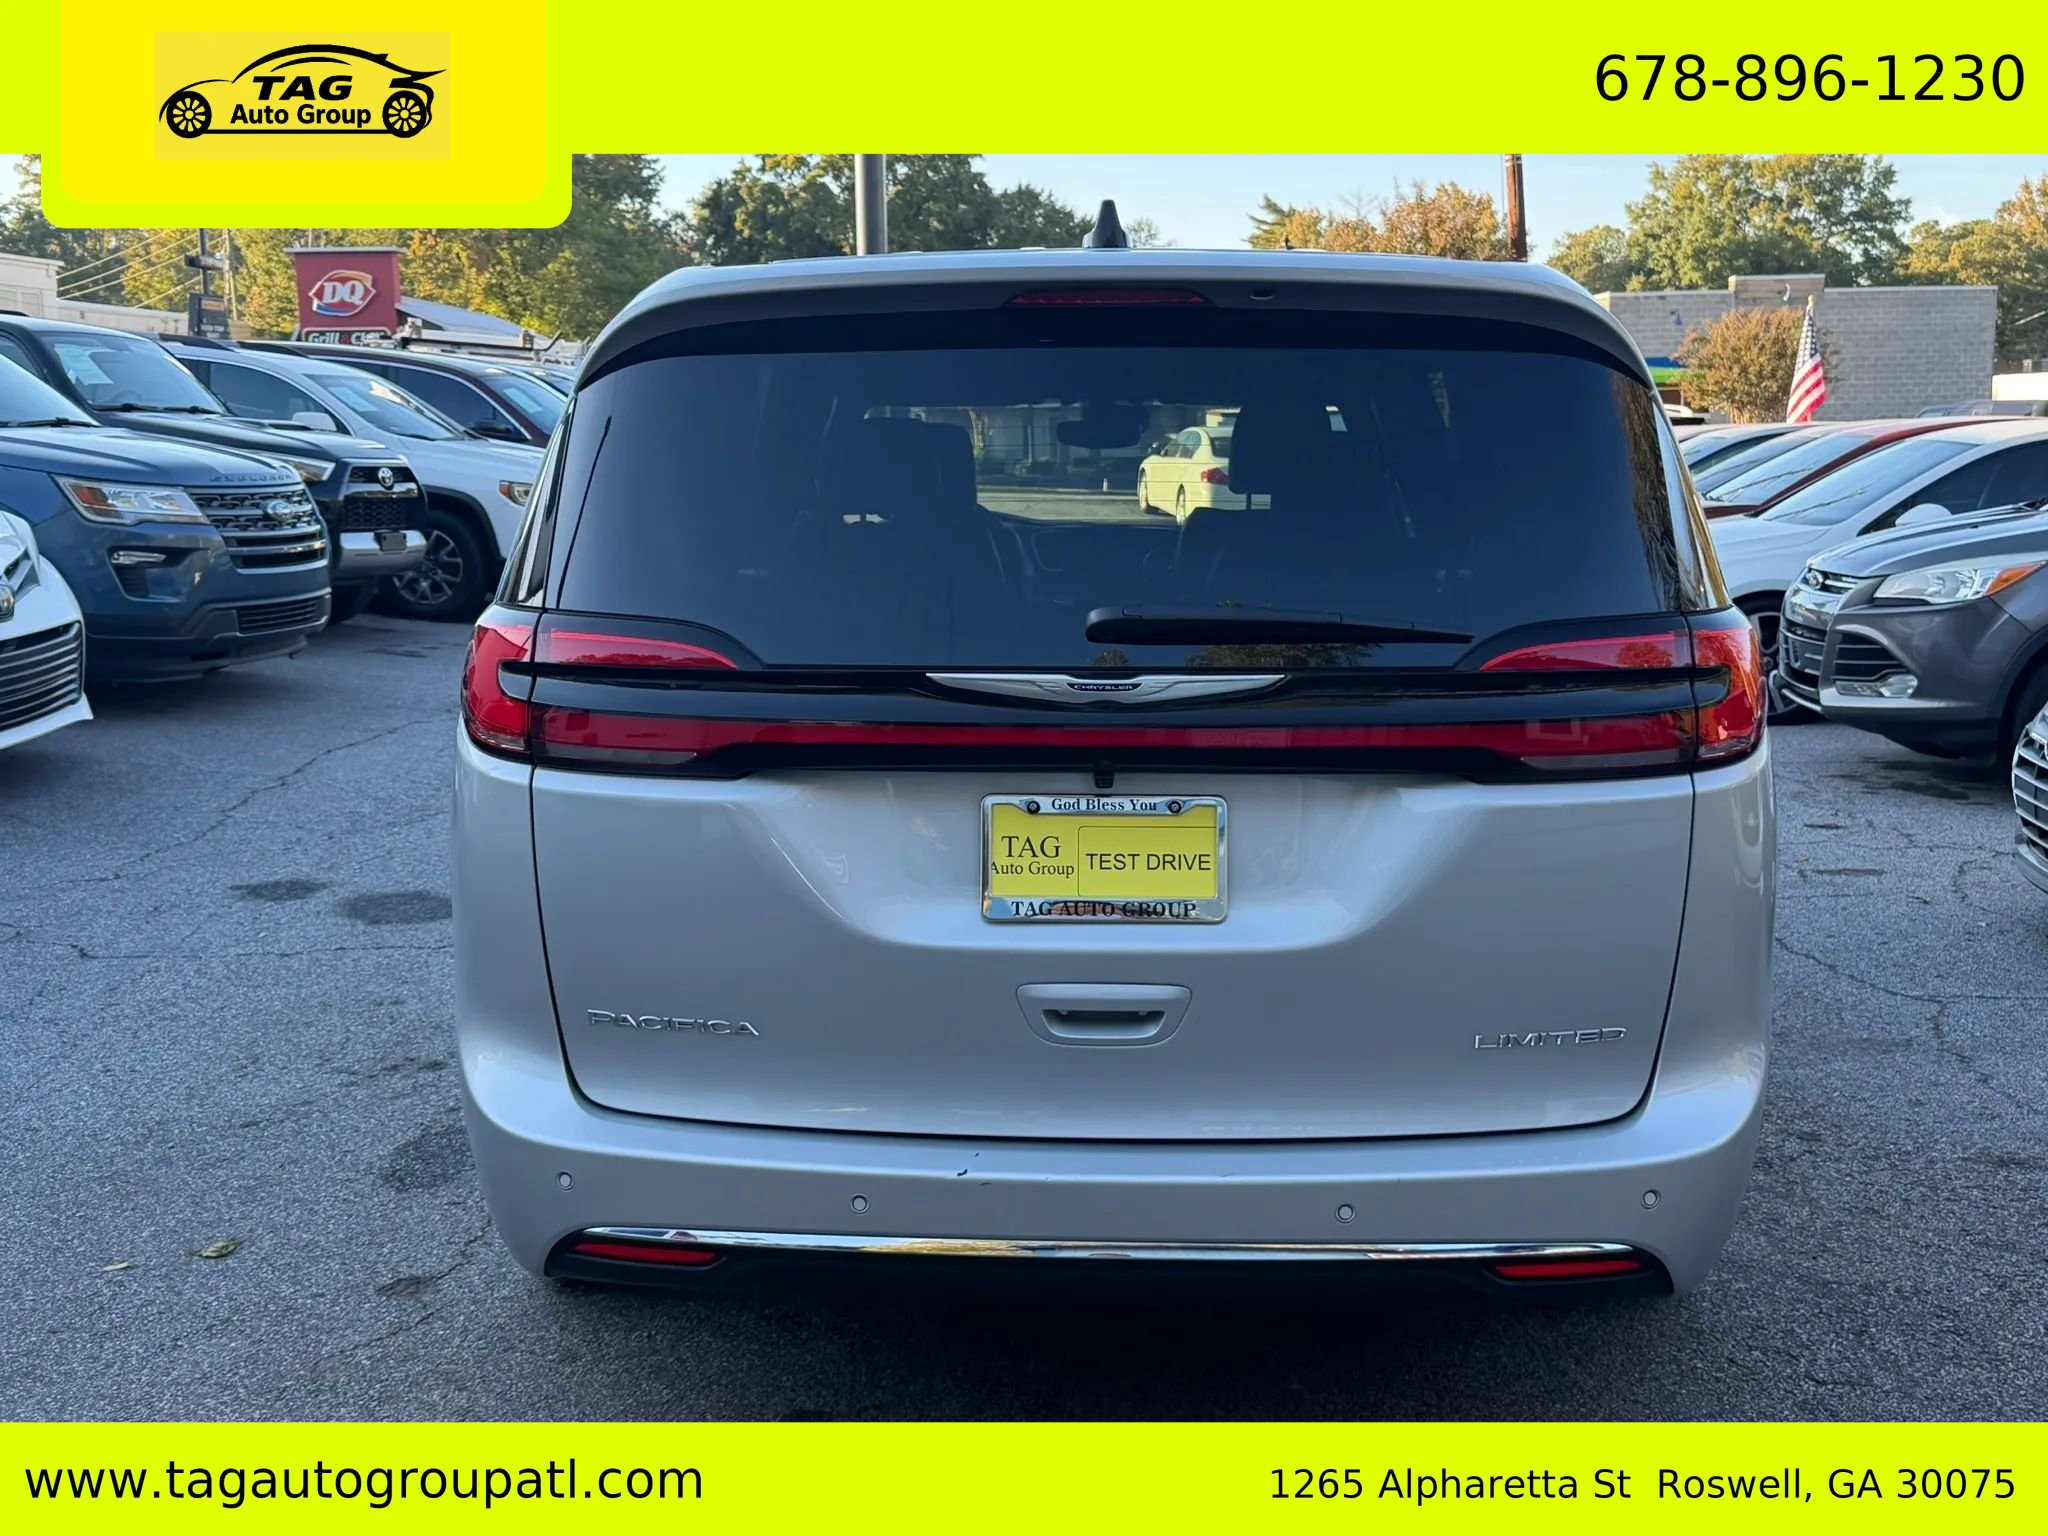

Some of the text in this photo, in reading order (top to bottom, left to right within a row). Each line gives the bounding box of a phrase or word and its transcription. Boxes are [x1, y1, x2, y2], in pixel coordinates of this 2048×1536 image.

[322, 280, 365, 305] DQ
[308, 332, 339, 344] Grill
[1051, 798, 1157, 811] God Bless You
[1001, 835, 1062, 858] TAG
[991, 861, 1075, 878] Auto Group
[1086, 853, 1211, 871] TEST DRIVE
[1011, 901, 1197, 917] TAG AUTO GROUP
[587, 1008, 760, 1037] PACIFICA
[1474, 1027, 1627, 1049] LIMITED
